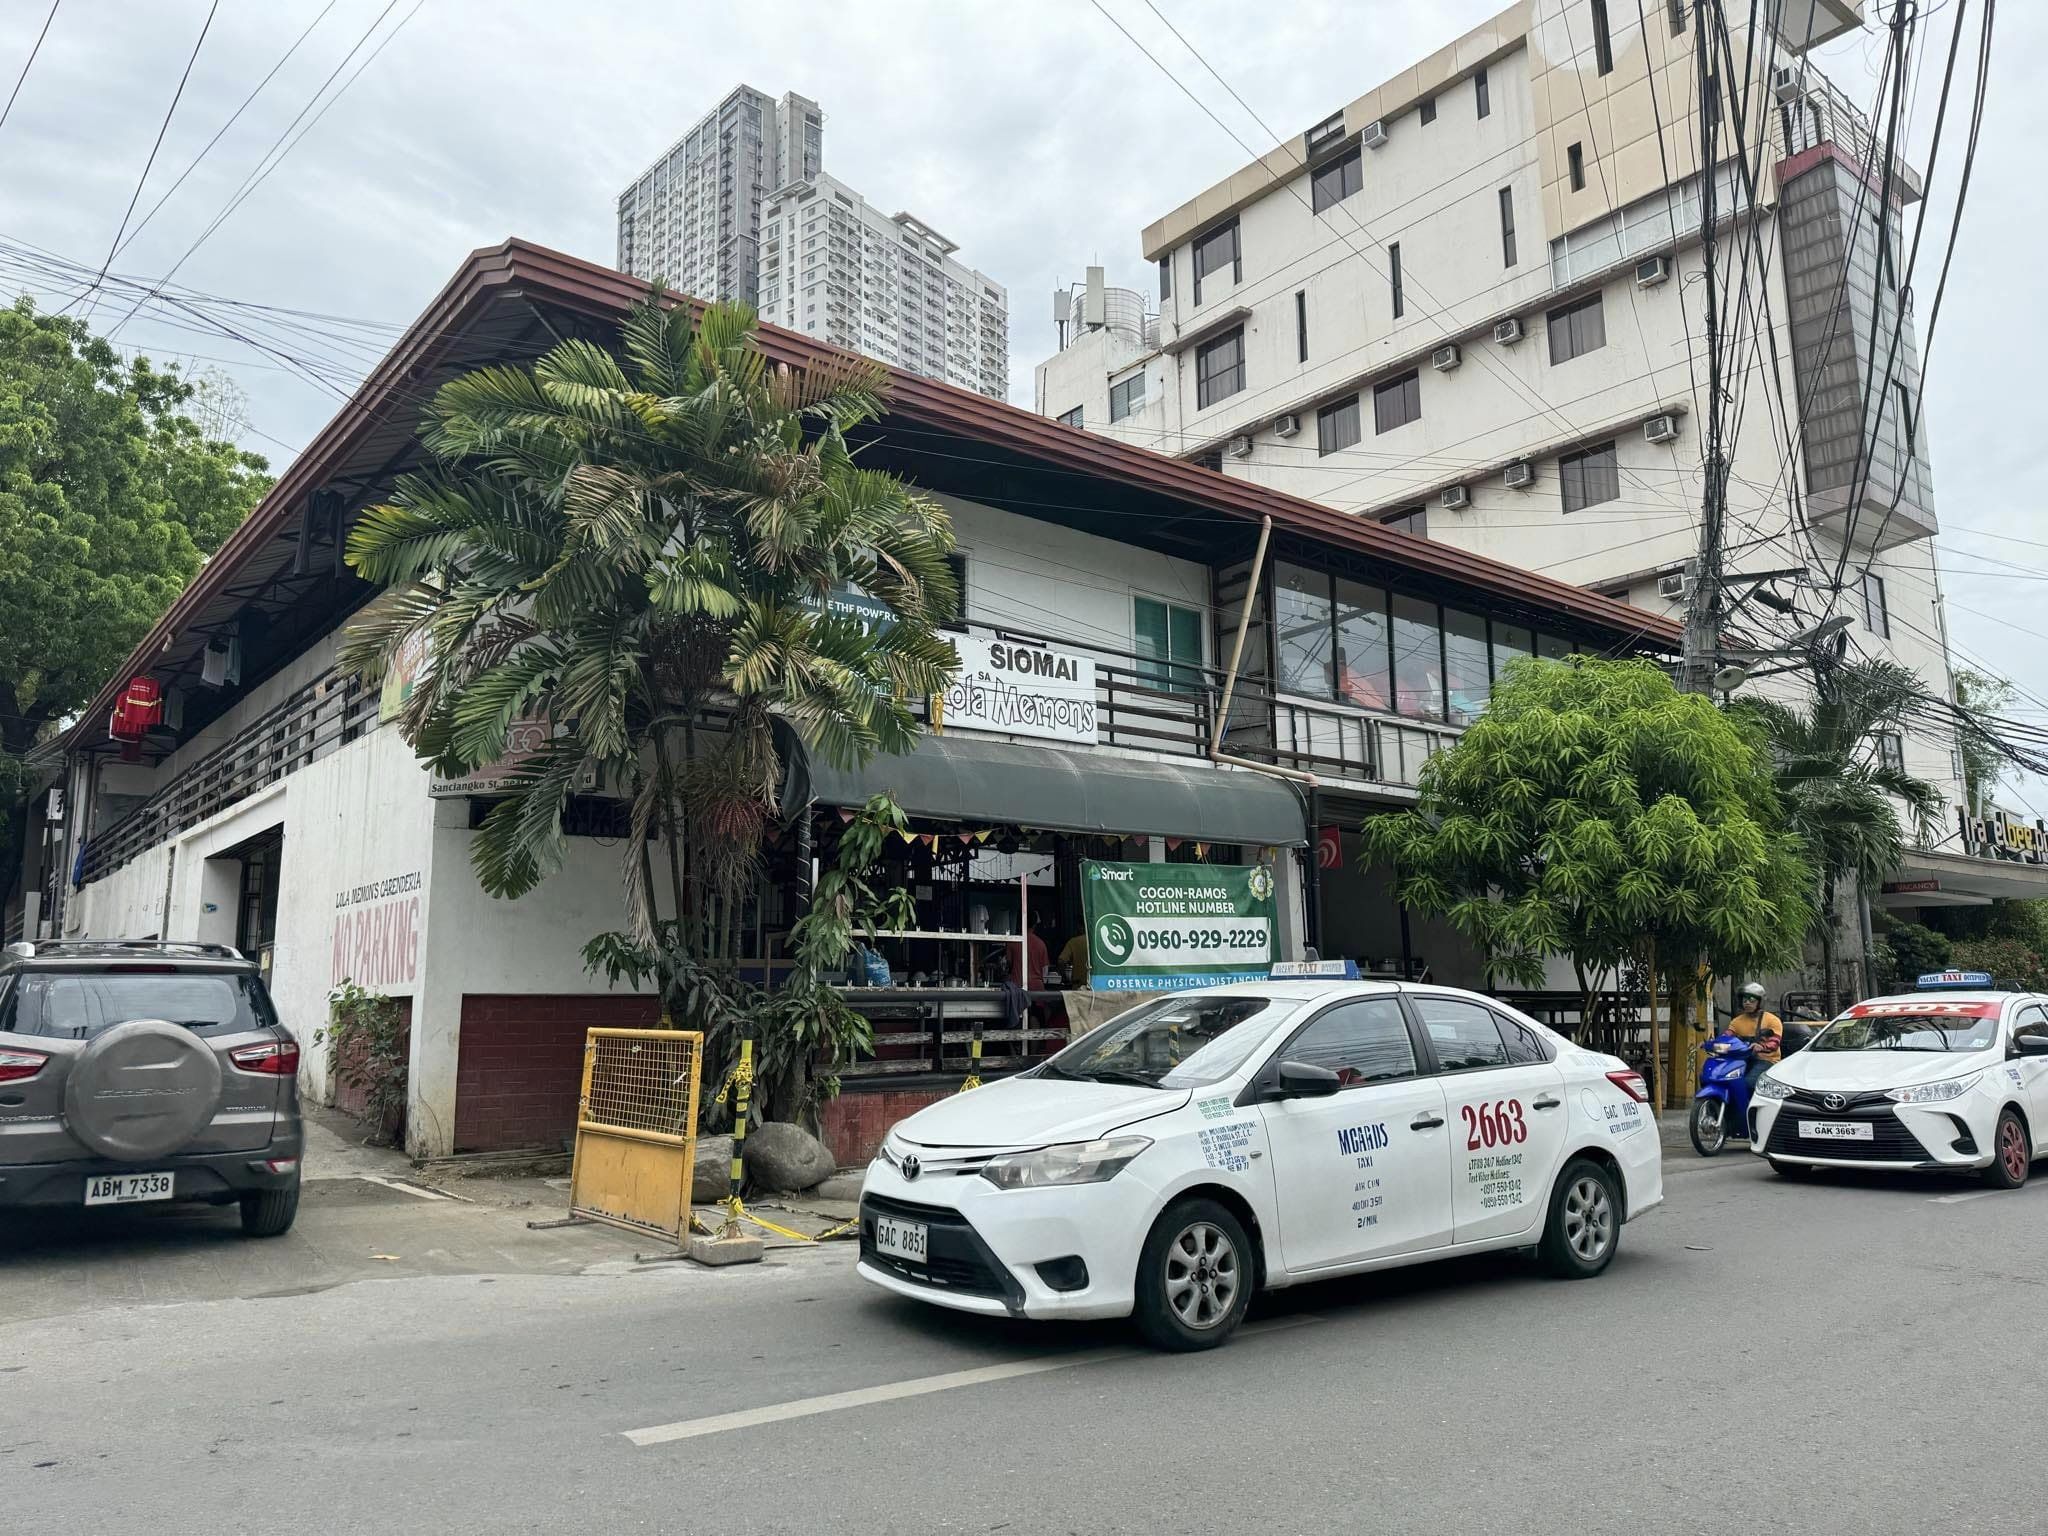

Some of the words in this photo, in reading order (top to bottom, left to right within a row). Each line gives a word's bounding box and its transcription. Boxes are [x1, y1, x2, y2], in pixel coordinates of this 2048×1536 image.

[856, 605, 890, 621] POWER
[990, 643, 1078, 682] SIOMAI
[978, 671, 991, 682] SA
[991, 676, 1095, 735] Memons
[431, 781, 485, 792] Sanciangko
[1101, 867, 1134, 881] Smart
[335, 889, 350, 909] LOLA
[380, 871, 421, 898] CARENDERIA
[1139, 886, 1227, 899] COGON-RAMOS
[1136, 901, 1186, 914] HOTLINE
[1189, 901, 1235, 914] NUMBER
[331, 912, 352, 988] NO
[353, 896, 419, 986] PARKING
[1137, 929, 1267, 949] 0960-929-2229
[1298, 963, 1317, 974] TAXI
[1107, 979, 1154, 988] OBSERVE
[1158, 977, 1207, 987] PHYSICAL
[1942, 973, 1962, 982] TAXI
[1461, 1098, 1527, 1151] 2663
[1815, 1127, 1833, 1135] GAK
[1357, 1156, 1373, 1169] TAXI
[91, 1180, 122, 1198] ABM
[130, 1177, 170, 1195] 7338
[878, 1224, 896, 1247] GAC
[902, 1230, 925, 1255] 8851
